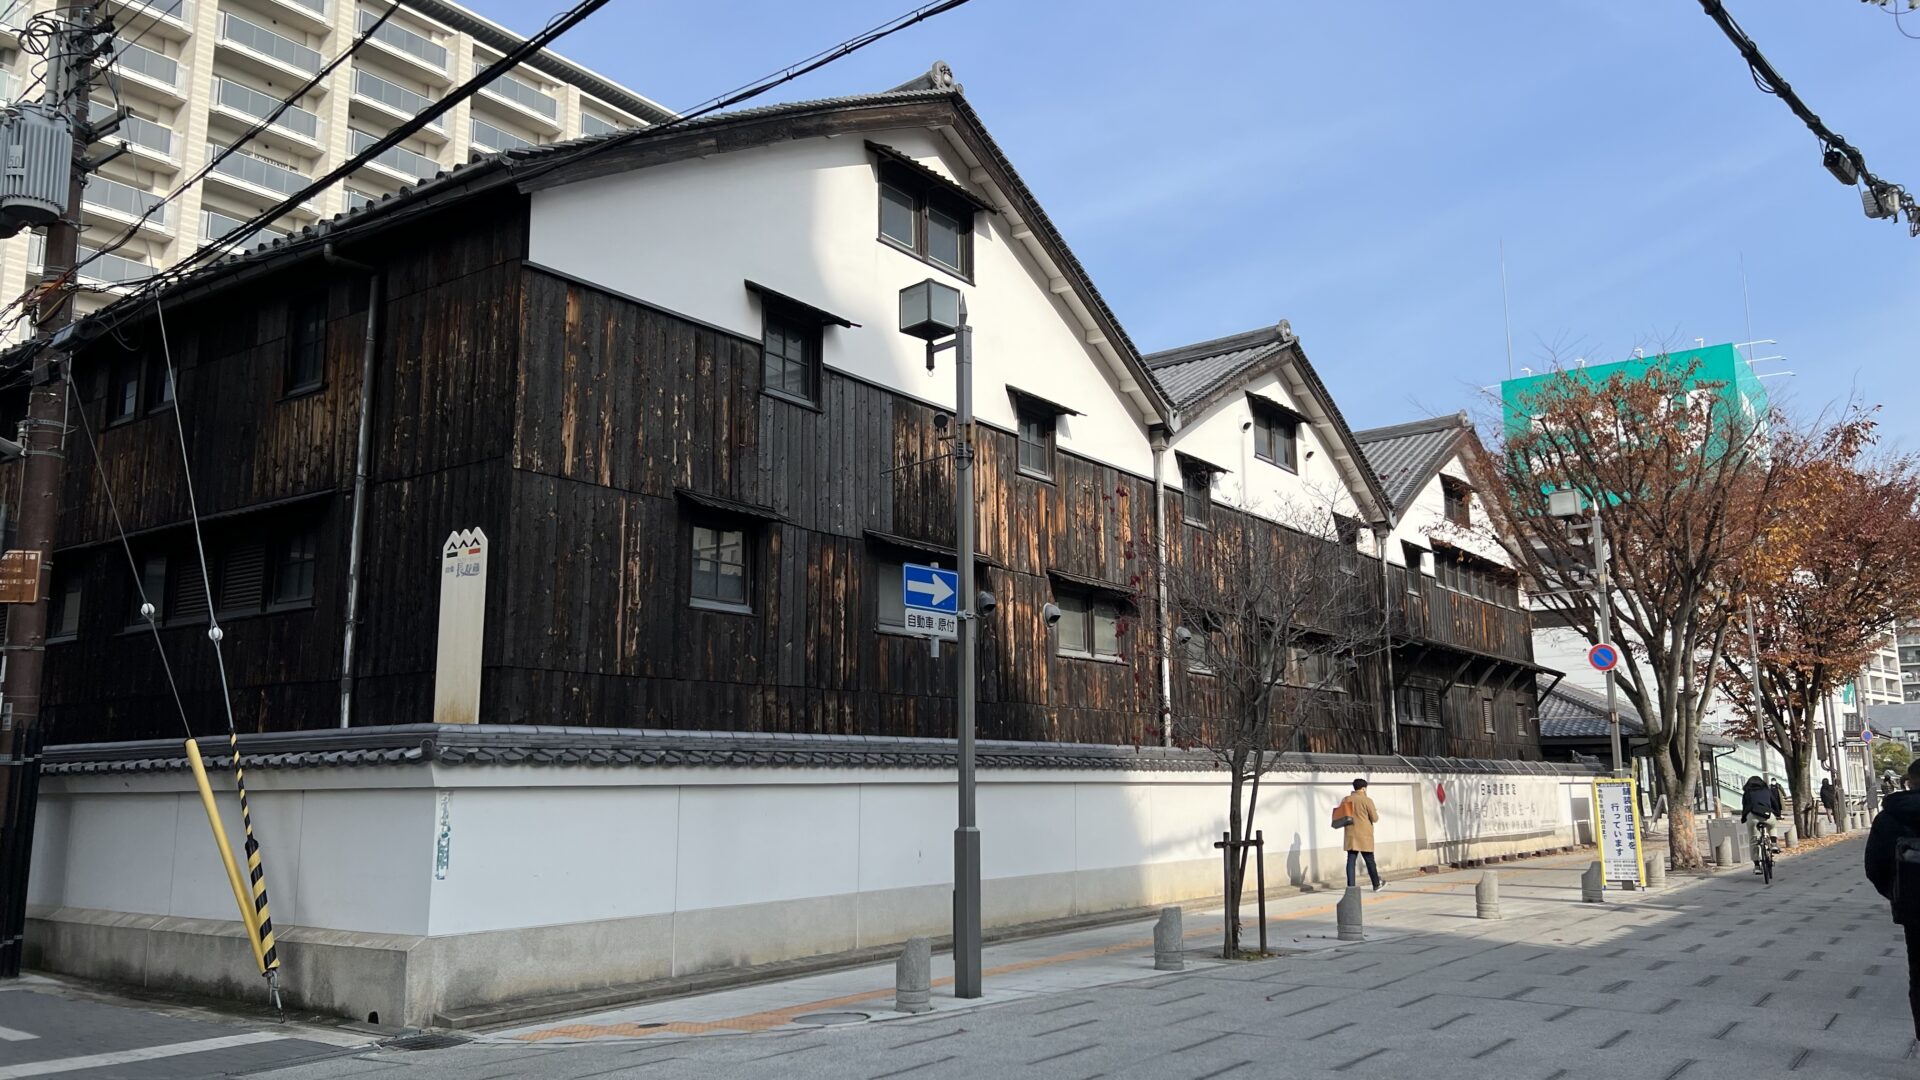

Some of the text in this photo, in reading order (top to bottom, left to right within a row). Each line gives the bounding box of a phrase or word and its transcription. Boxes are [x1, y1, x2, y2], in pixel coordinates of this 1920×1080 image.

[1610, 803, 1624, 857] 行っています
[1622, 787, 1636, 850] 舗装復旧工事を
